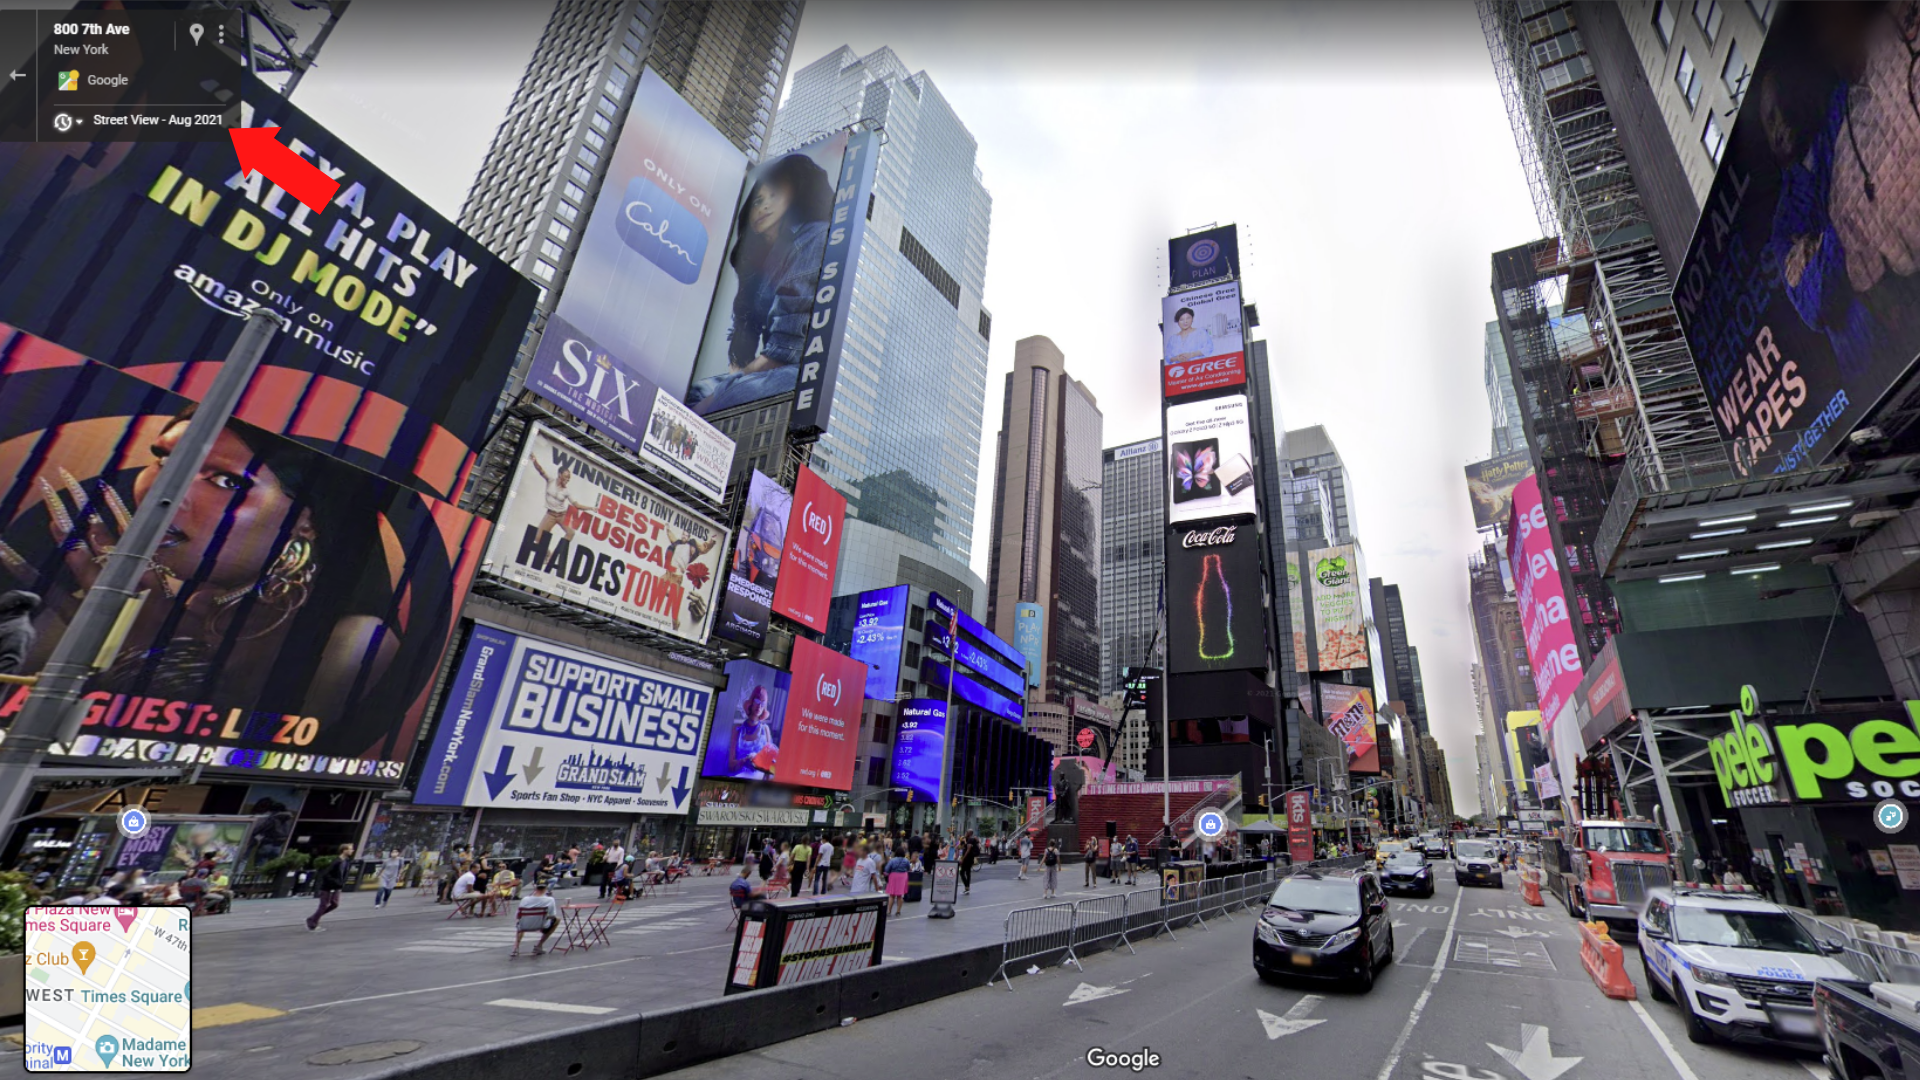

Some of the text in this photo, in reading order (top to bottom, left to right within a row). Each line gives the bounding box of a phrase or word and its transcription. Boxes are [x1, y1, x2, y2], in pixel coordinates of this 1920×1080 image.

[643, 158, 712, 218] ONLY ON
[148, 165, 220, 226] IN
[222, 208, 291, 266] DJ
[625, 200, 698, 266] Calm
[325, 219, 421, 297] HITS
[387, 212, 477, 288] PLAY
[796, 144, 862, 411] TIMES SQUARE
[1192, 266, 1216, 279] PLAN
[251, 279, 334, 332] Only on
[1180, 287, 1235, 303] Chinese Gree
[1187, 293, 1236, 307] Global Gree
[173, 264, 376, 376] amazn music
[1187, 357, 1237, 375] GREE
[1205, 368, 1241, 380] Conditioning
[552, 338, 640, 425] SIX
[1717, 325, 1781, 435] WEAR
[568, 386, 584, 402] THE
[1215, 403, 1243, 411] SAMSUNG
[1733, 359, 1807, 477] CAPES
[1120, 445, 1146, 457] Allianz
[696, 452, 726, 479] WRONG
[1481, 467, 1503, 482] Harry
[1503, 460, 1528, 474] Potter
[552, 446, 709, 542] WINNER! 8 TONY AWARDS
[597, 495, 664, 541] BEST
[802, 501, 832, 545] (RED)
[563, 505, 677, 573] MUSICAL
[727, 581, 773, 608] RESPONSE
[729, 572, 774, 599] EMERGENCY
[725, 621, 761, 638] ARCIMOTO
[1018, 622, 1040, 635] PLAY
[1020, 634, 1039, 647] NPR
[525, 653, 639, 700] SUPPORT
[640, 683, 702, 715] SMALL
[816, 673, 842, 706] (RED)
[81, 691, 219, 737] GUEST:
[433, 645, 494, 794] GrandSlamNewYork.com
[509, 681, 700, 751] BUSINESS
[801, 707, 845, 727] We were made
[903, 708, 945, 718] Natural Gas
[798, 721, 808, 732] for
[808, 724, 819, 735] this
[557, 763, 647, 787] GRAND SLAM
[1183, 781, 1199, 792] WEEK
[511, 789, 668, 806] Sports Fan Shop NYC Apparel Souvenirs
[1733, 785, 1775, 806] SOCCER
[699, 810, 809, 824] SWAROVSKI SWAROVSKI
[1291, 794, 1306, 823] tkts
[123, 840, 162, 852] MON
[1469, 907, 1552, 921] ONLY
[782, 942, 873, 963] #STOPASIANHATE
[1756, 970, 1804, 980] POLICE
